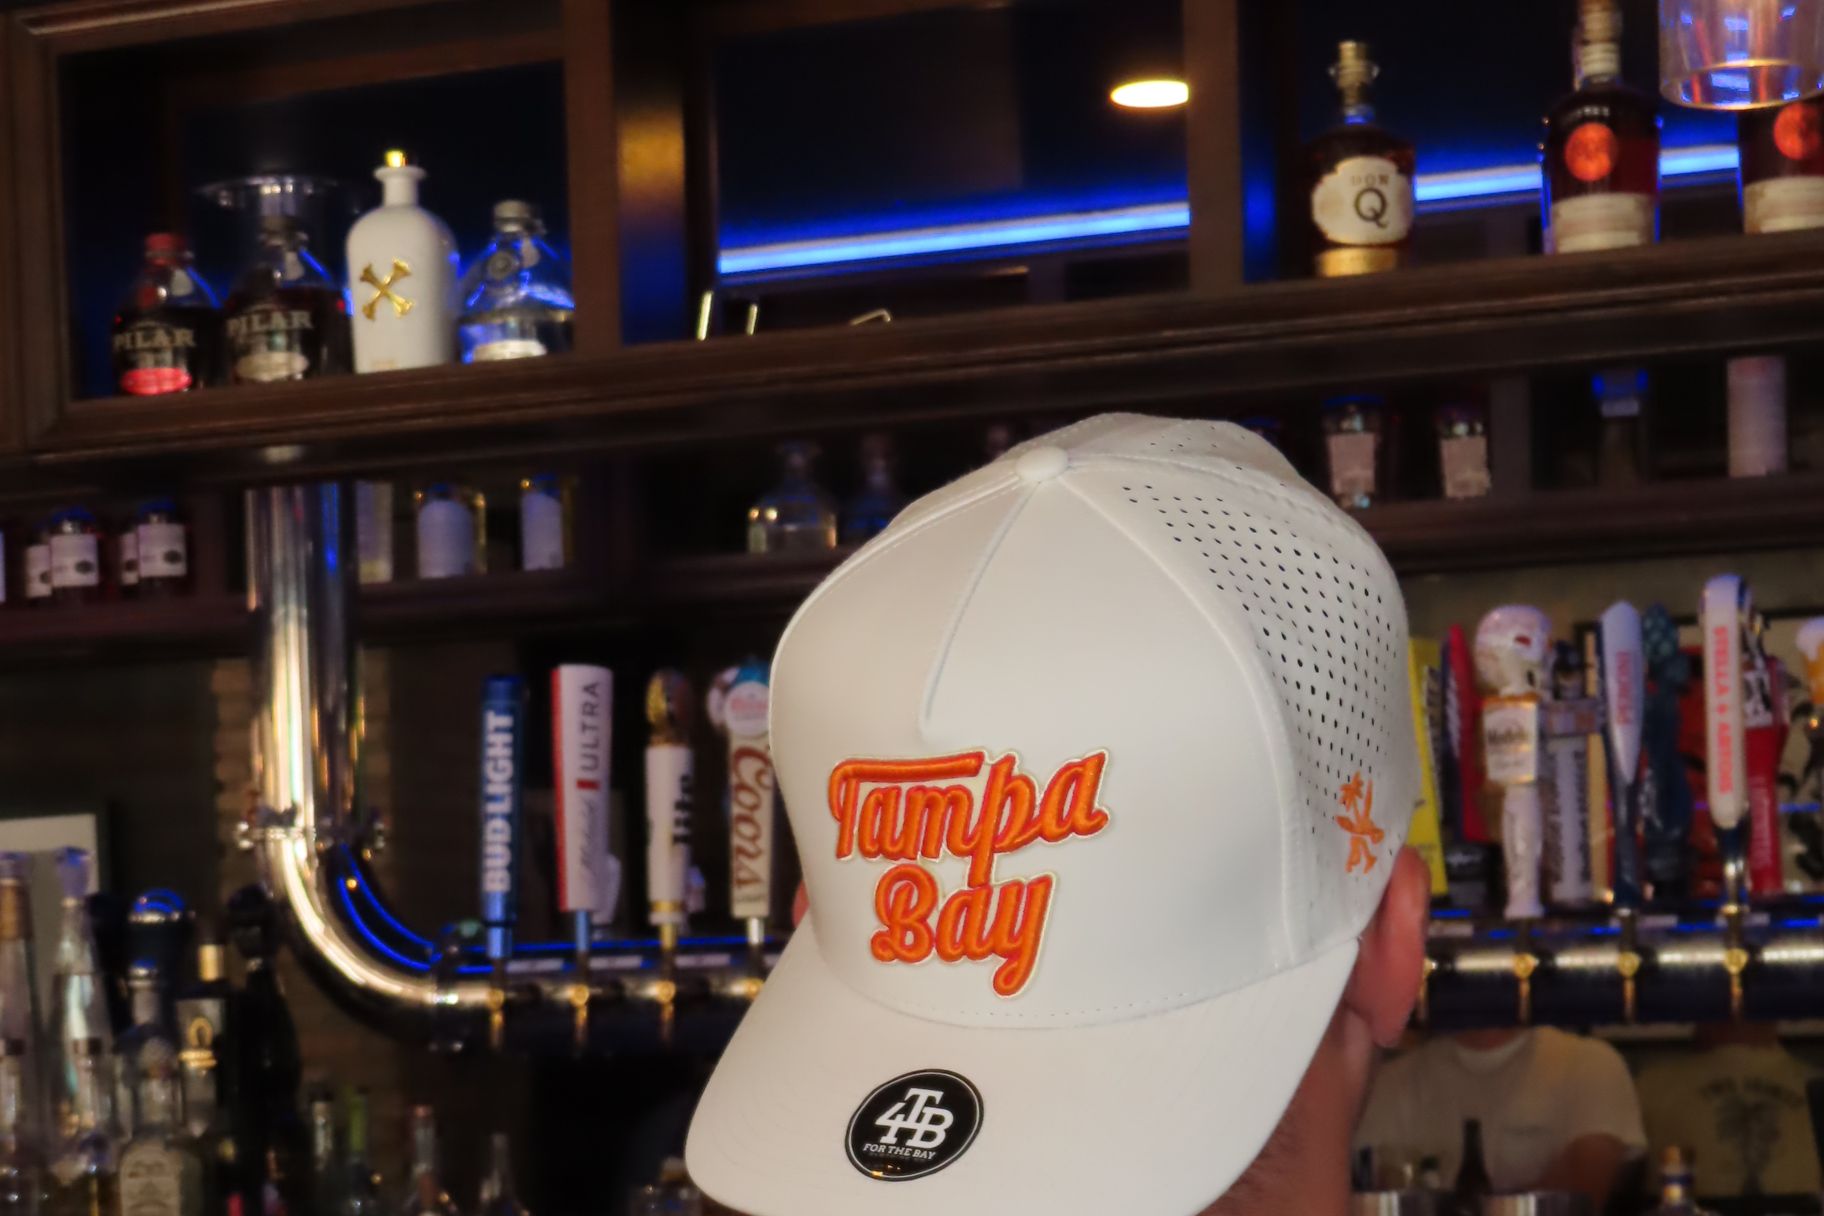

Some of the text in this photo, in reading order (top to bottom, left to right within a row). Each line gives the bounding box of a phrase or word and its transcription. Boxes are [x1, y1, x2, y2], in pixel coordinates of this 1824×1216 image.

[1353, 187, 1389, 229] Q
[112, 328, 197, 350] PILAR
[226, 310, 314, 335] PILAR
[579, 681, 601, 773] ULTRA
[482, 710, 514, 892] BUD LIGHT
[733, 746, 771, 888] Coors
[827, 750, 1109, 889] Tampa
[870, 863, 1054, 997] Bay
[863, 1143, 937, 1161] FOR THE BAY
